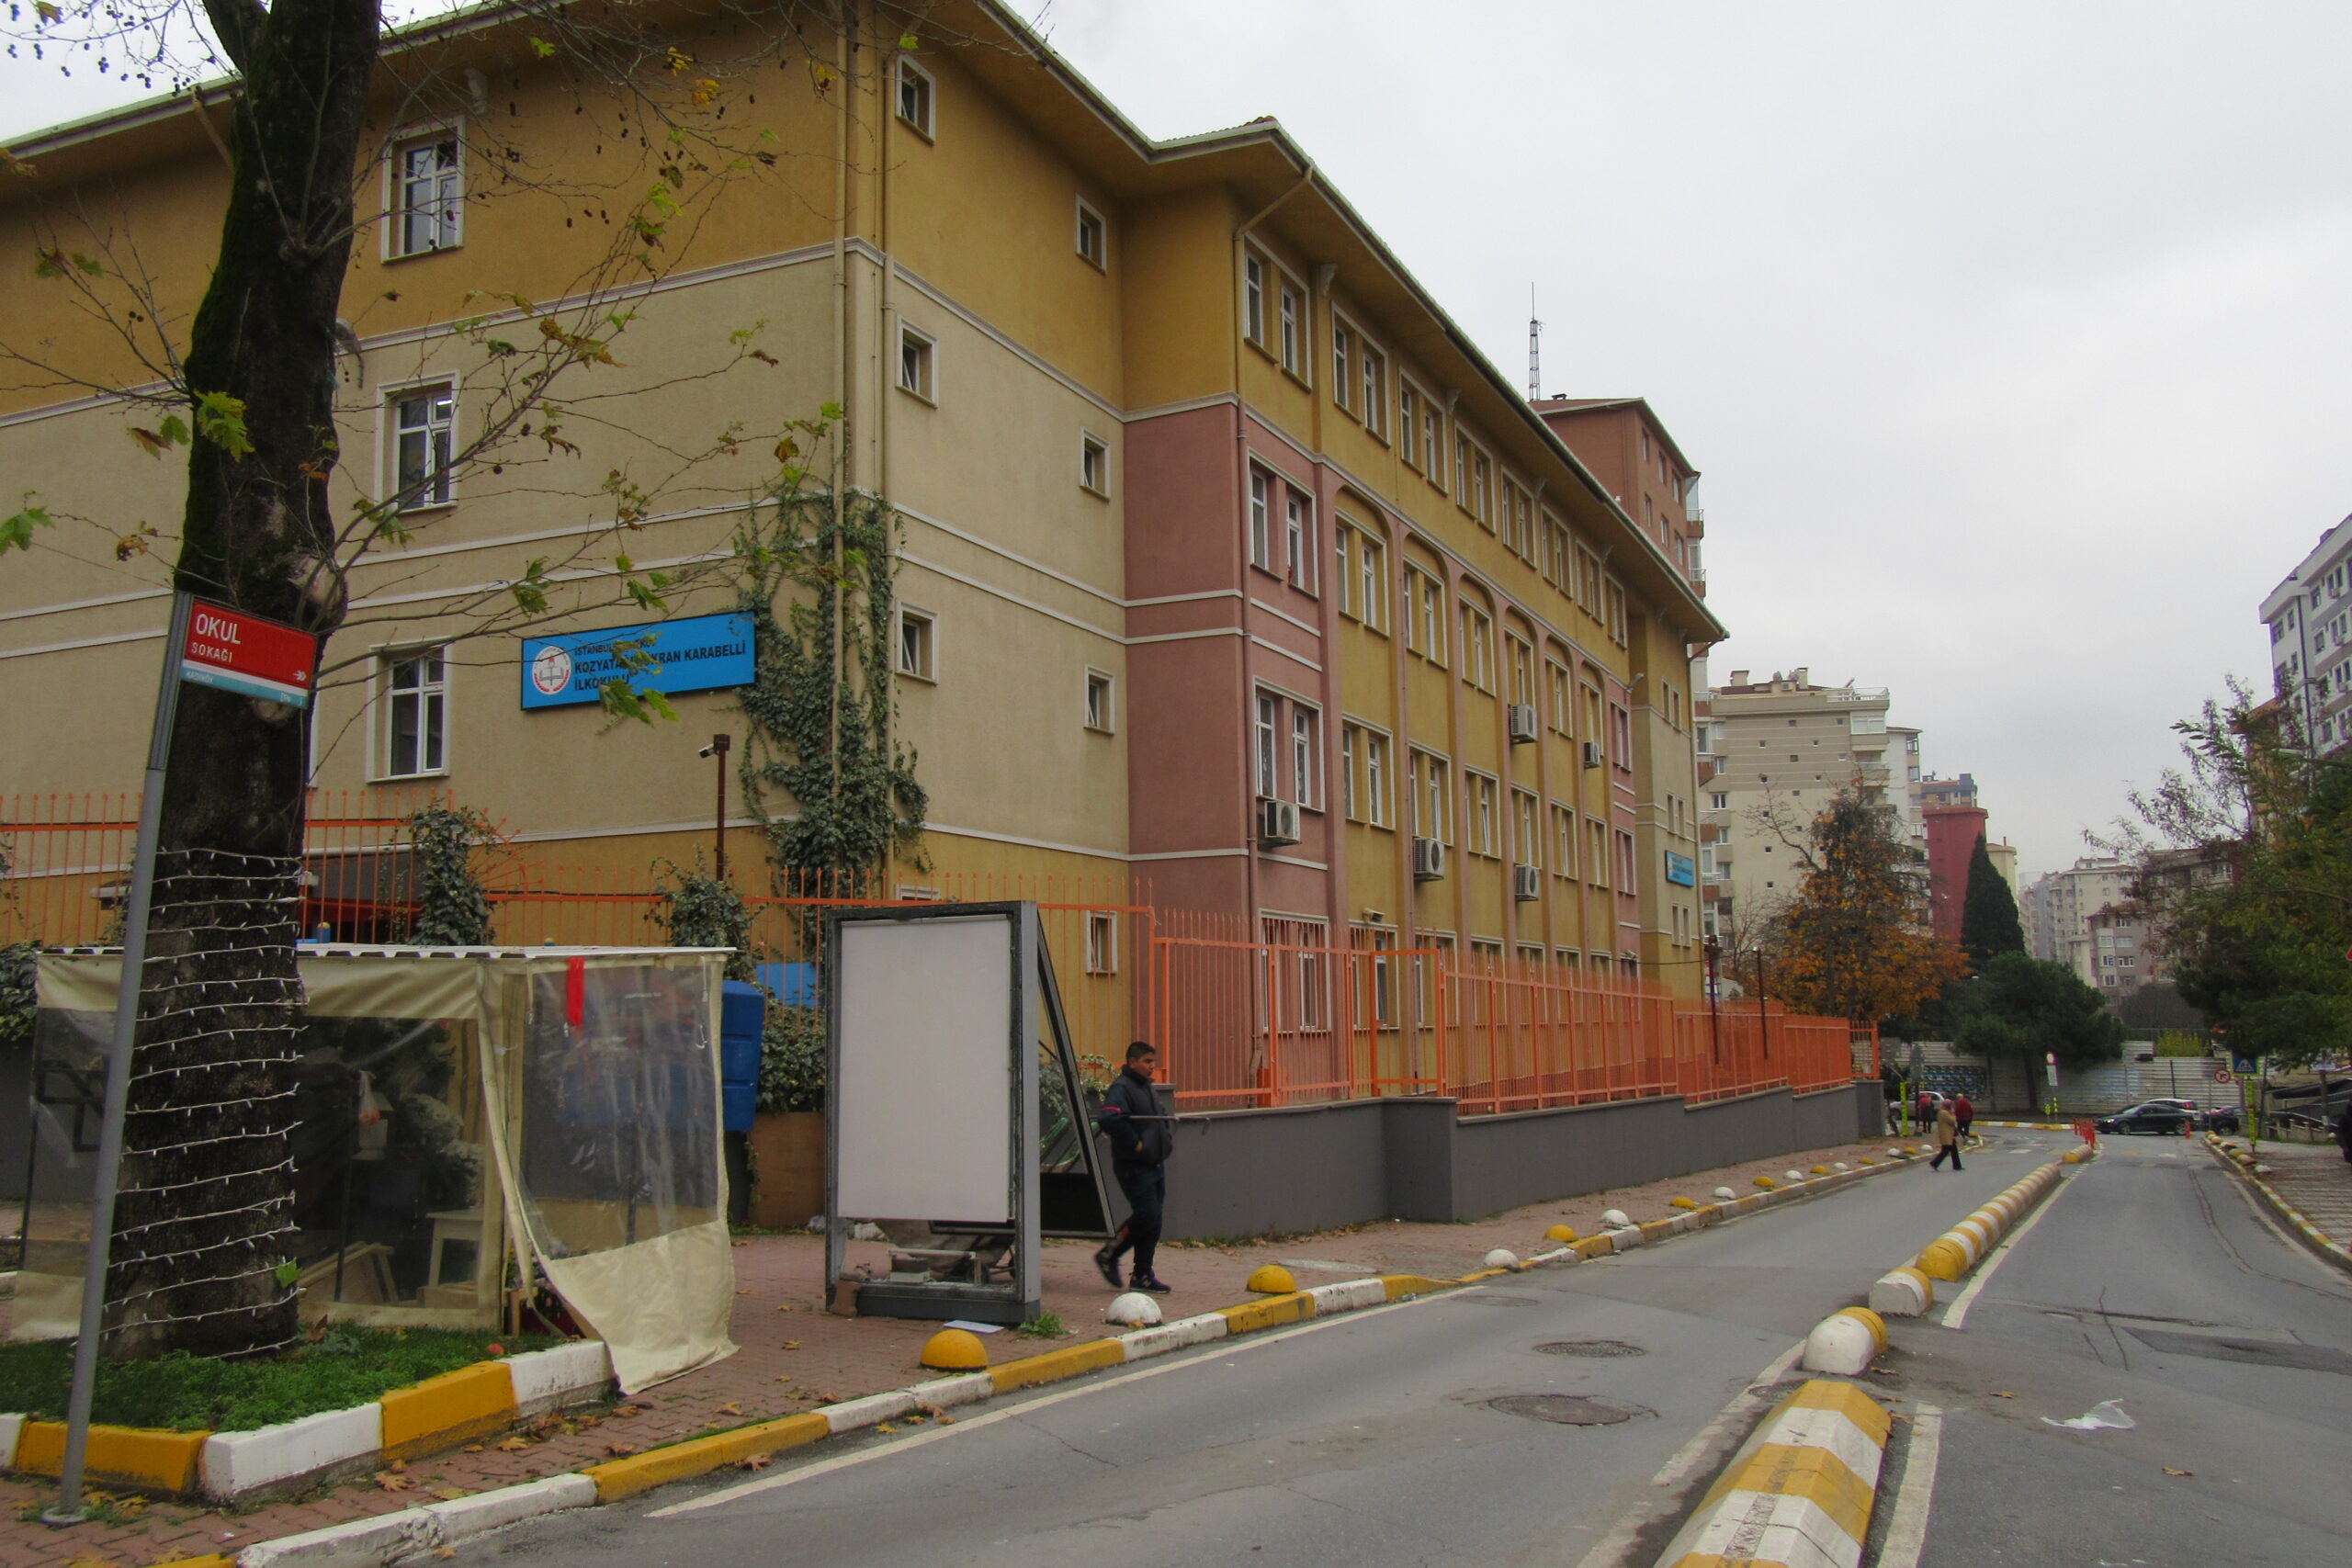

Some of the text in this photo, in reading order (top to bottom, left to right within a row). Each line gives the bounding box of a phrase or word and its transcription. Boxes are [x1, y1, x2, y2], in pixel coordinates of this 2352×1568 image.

[196, 614, 242, 645] OKUL
[191, 642, 232, 662] SOKAĞI
[684, 639, 746, 661] KARABELLİ
